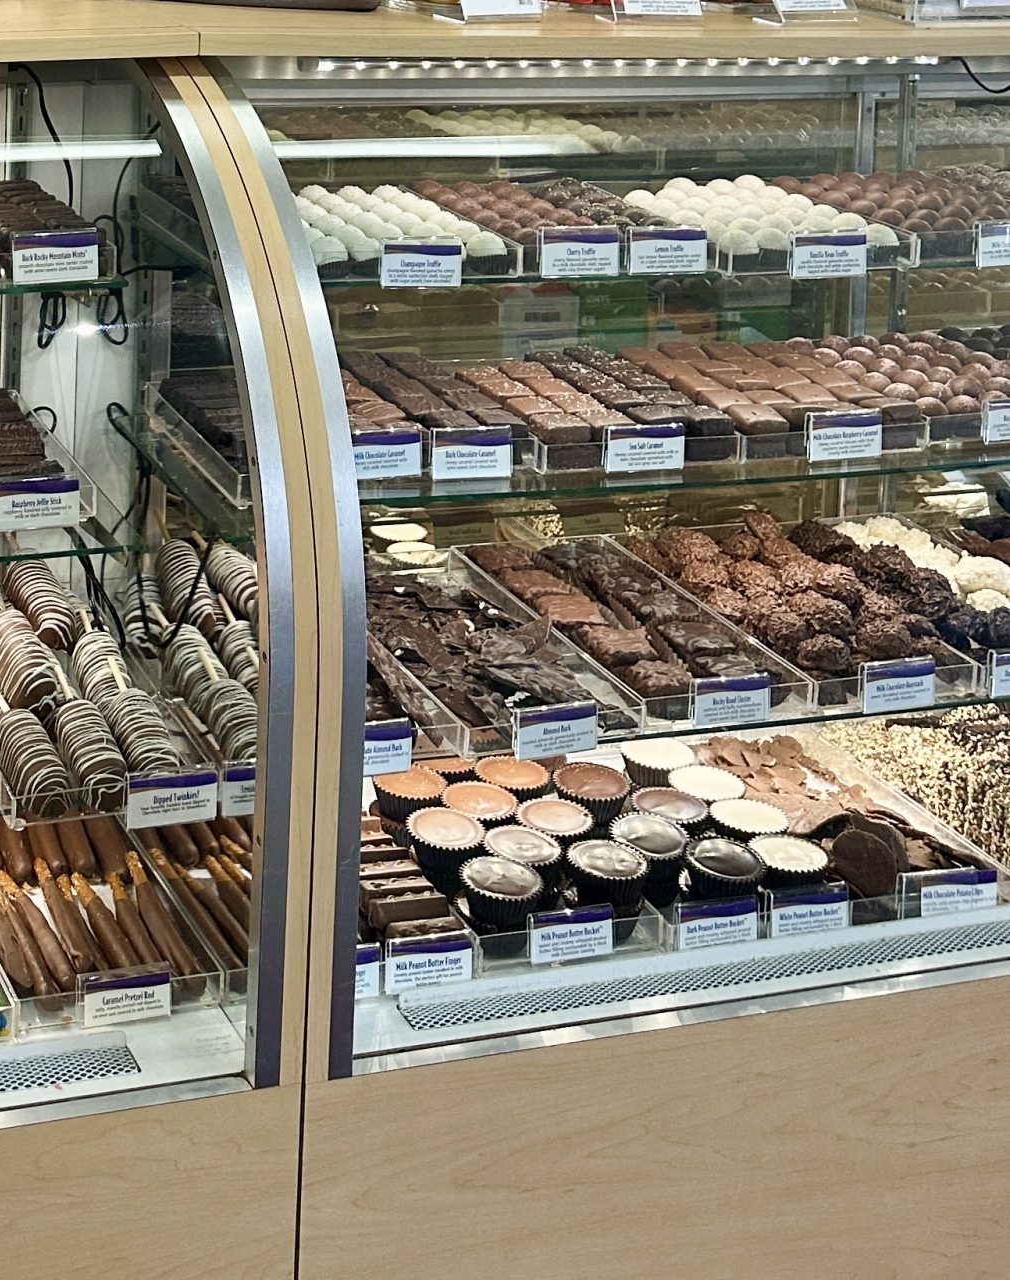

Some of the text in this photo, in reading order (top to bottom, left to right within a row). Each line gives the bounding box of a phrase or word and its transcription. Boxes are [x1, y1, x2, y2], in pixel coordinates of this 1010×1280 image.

[12, 499, 35, 508] Raspberry
[541, 932, 551, 941] Milk
[552, 930, 569, 939] Peanut
[396, 962, 407, 971] Milk
[409, 959, 427, 969] Peanut
[428, 957, 444, 967] Butter
[102, 990, 155, 1005] Caramel Pretzel Rod
